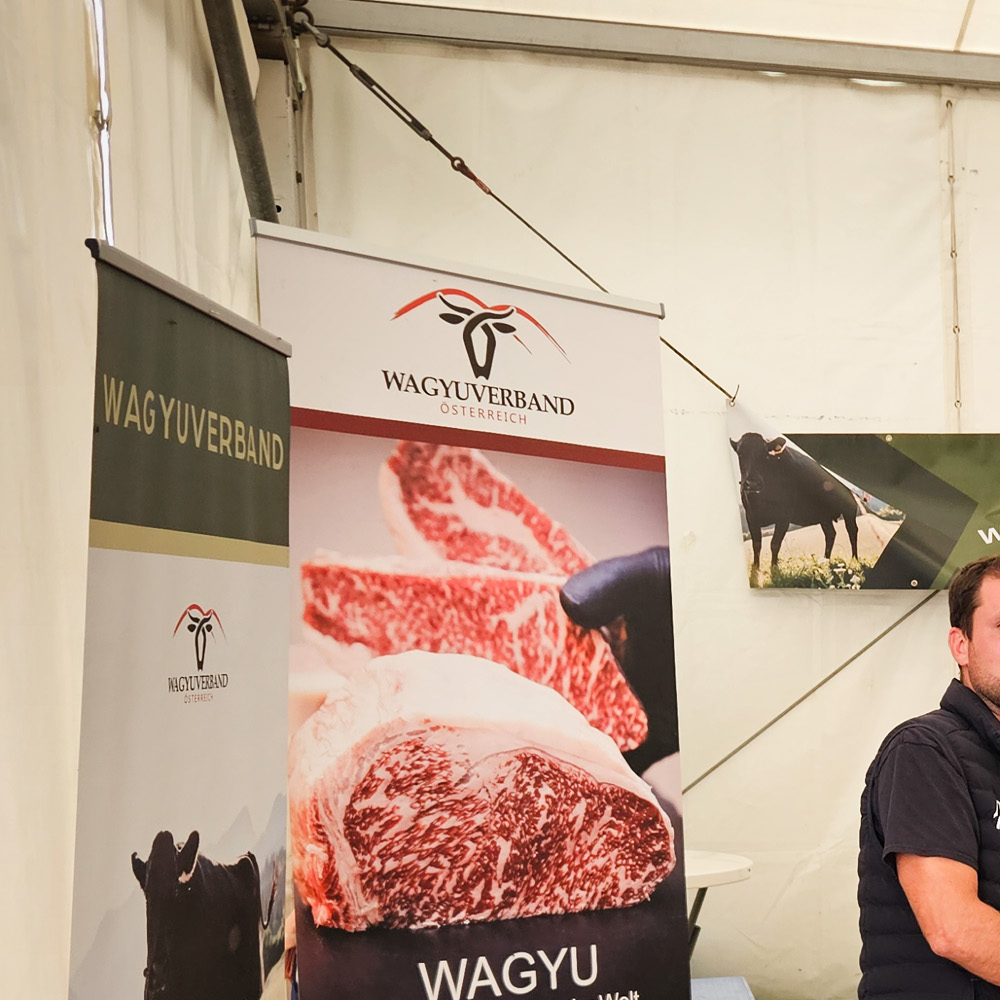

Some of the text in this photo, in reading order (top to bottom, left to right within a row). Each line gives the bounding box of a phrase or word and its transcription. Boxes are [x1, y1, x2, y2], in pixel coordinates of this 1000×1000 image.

[382, 369, 575, 416] WAGYUVERBAND
[102, 373, 285, 472] WAGYUVERBAND
[440, 401, 527, 425] ÖSTERREICH
[168, 674, 229, 693] WAGYUVERBAND
